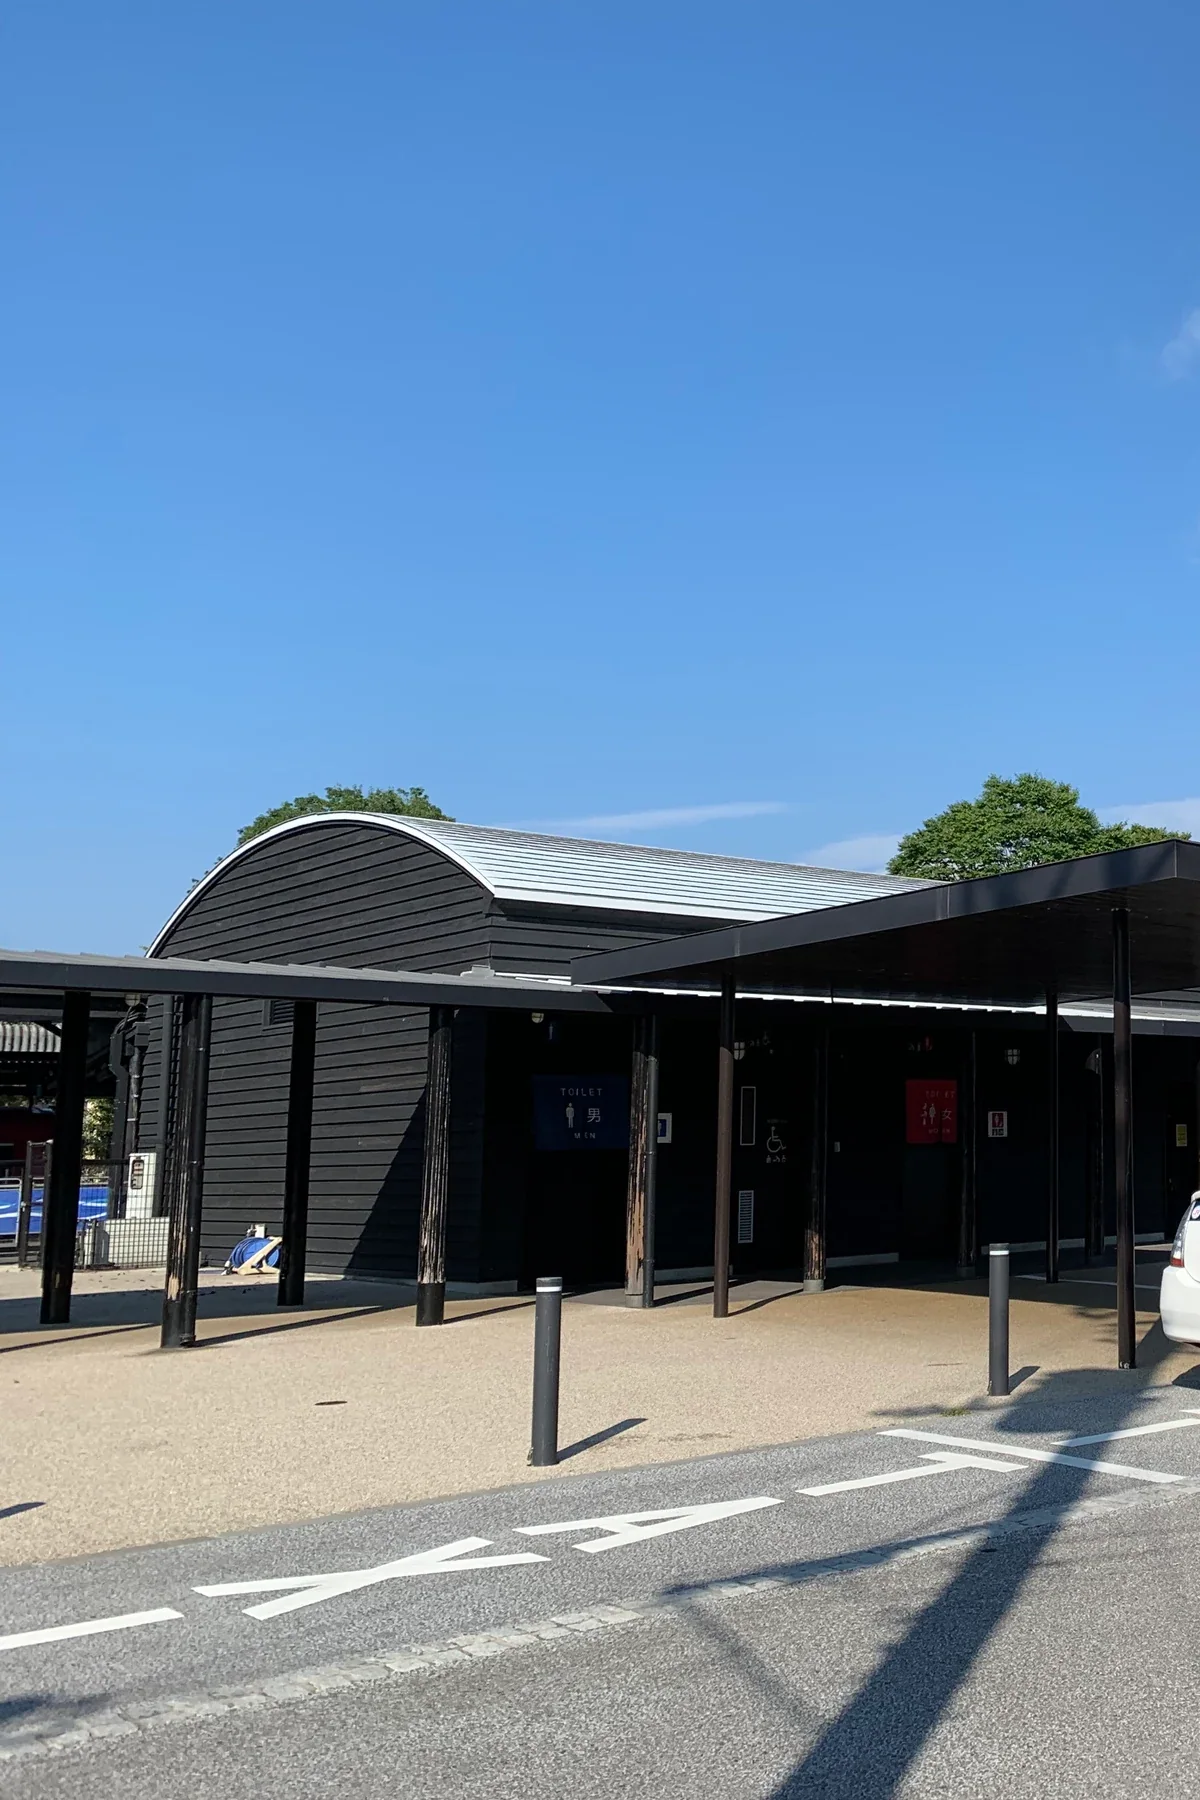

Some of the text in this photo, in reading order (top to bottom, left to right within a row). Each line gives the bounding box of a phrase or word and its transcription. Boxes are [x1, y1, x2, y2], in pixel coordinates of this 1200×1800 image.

[560, 1088, 603, 1097] TOILET
[587, 1108, 601, 1123] 男
[941, 1108, 952, 1120] 女
